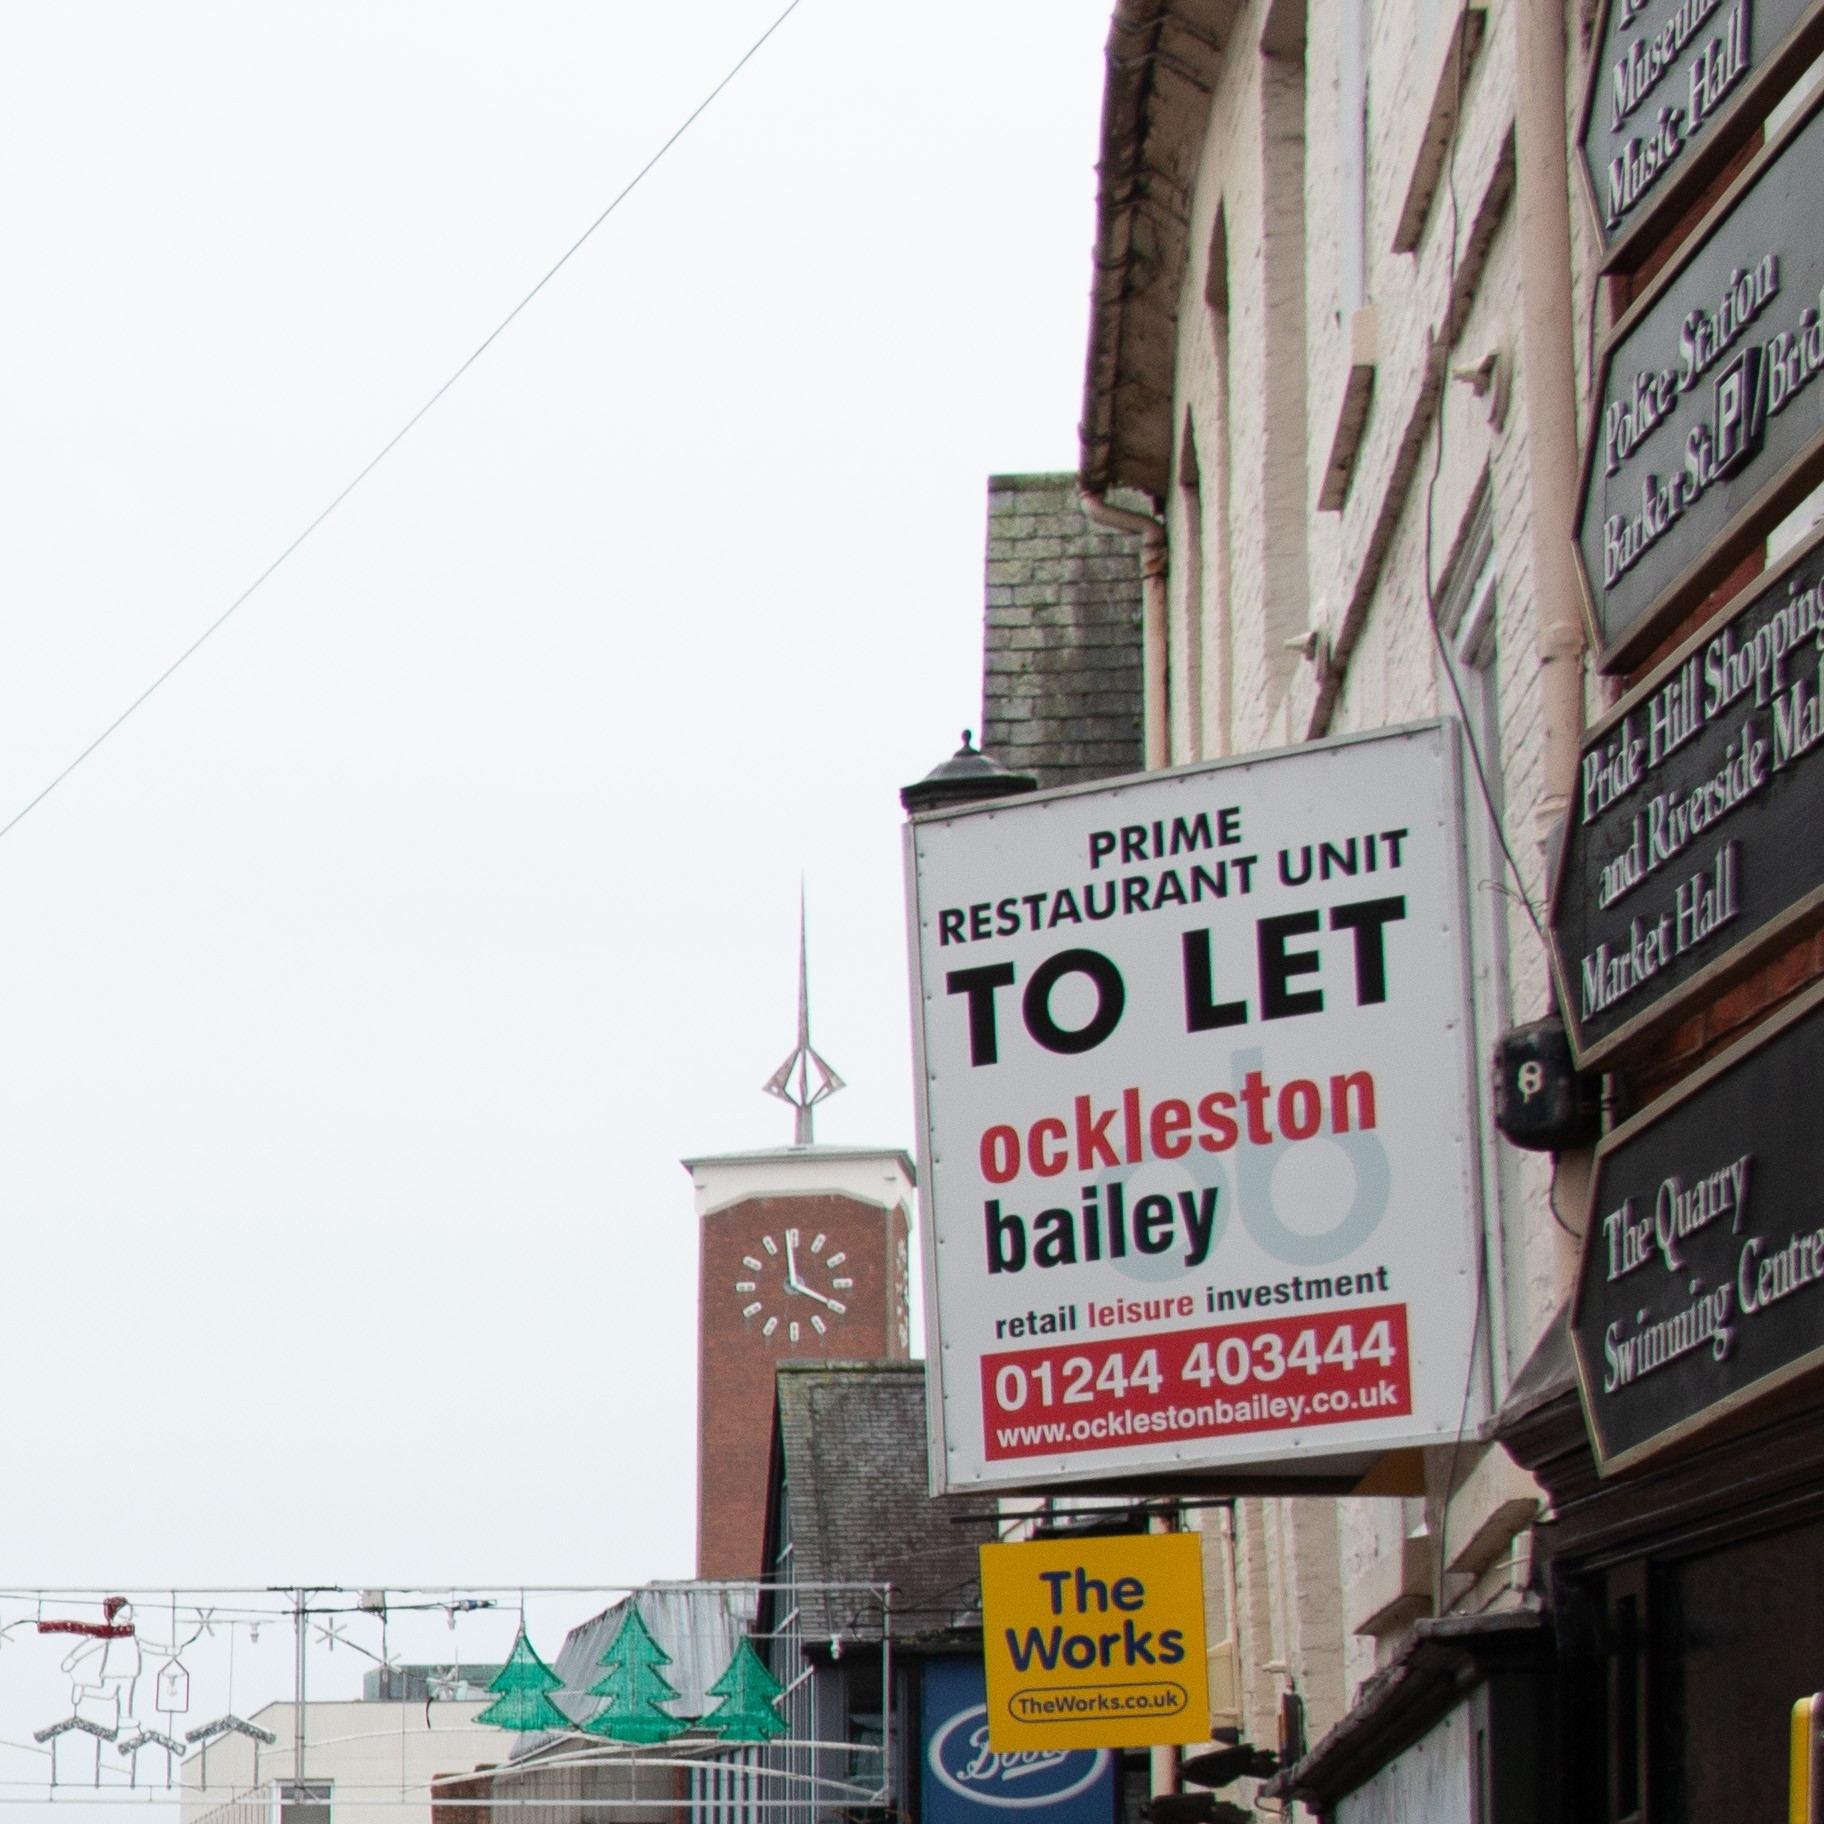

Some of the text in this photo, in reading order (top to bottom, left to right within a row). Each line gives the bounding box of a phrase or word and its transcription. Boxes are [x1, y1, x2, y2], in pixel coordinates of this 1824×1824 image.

[1605, 0, 1752, 229] Music Hall
[1605, 254, 1779, 478] Police Station
[1604, 473, 1687, 590] Barker
[1582, 716, 1648, 826] Pride
[1647, 652, 1705, 770] Hill
[1088, 805, 1243, 870] PRIME
[1598, 810, 1648, 911] and
[1647, 720, 1769, 872] Riverside
[937, 827, 1411, 947] RESTAURANT UNIT
[1580, 839, 1740, 1024] Market Hall
[945, 894, 1408, 1068] TO LET
[978, 1068, 1378, 1184] ockleston
[984, 1182, 1220, 1275] bailey
[1603, 1153, 1752, 1283] The Quarry
[994, 1265, 1390, 1341] retail leisure investment
[1603, 1226, 1824, 1395] Swimming Centre
[995, 1318, 1398, 1412] 01244 403444
[996, 1380, 1398, 1450] www.ocklestonbailey.co.uk
[1005, 1618, 1186, 1672] Works
[1039, 1566, 1146, 1616] The
[1018, 1690, 1178, 1716] TheWorks.co.uk
